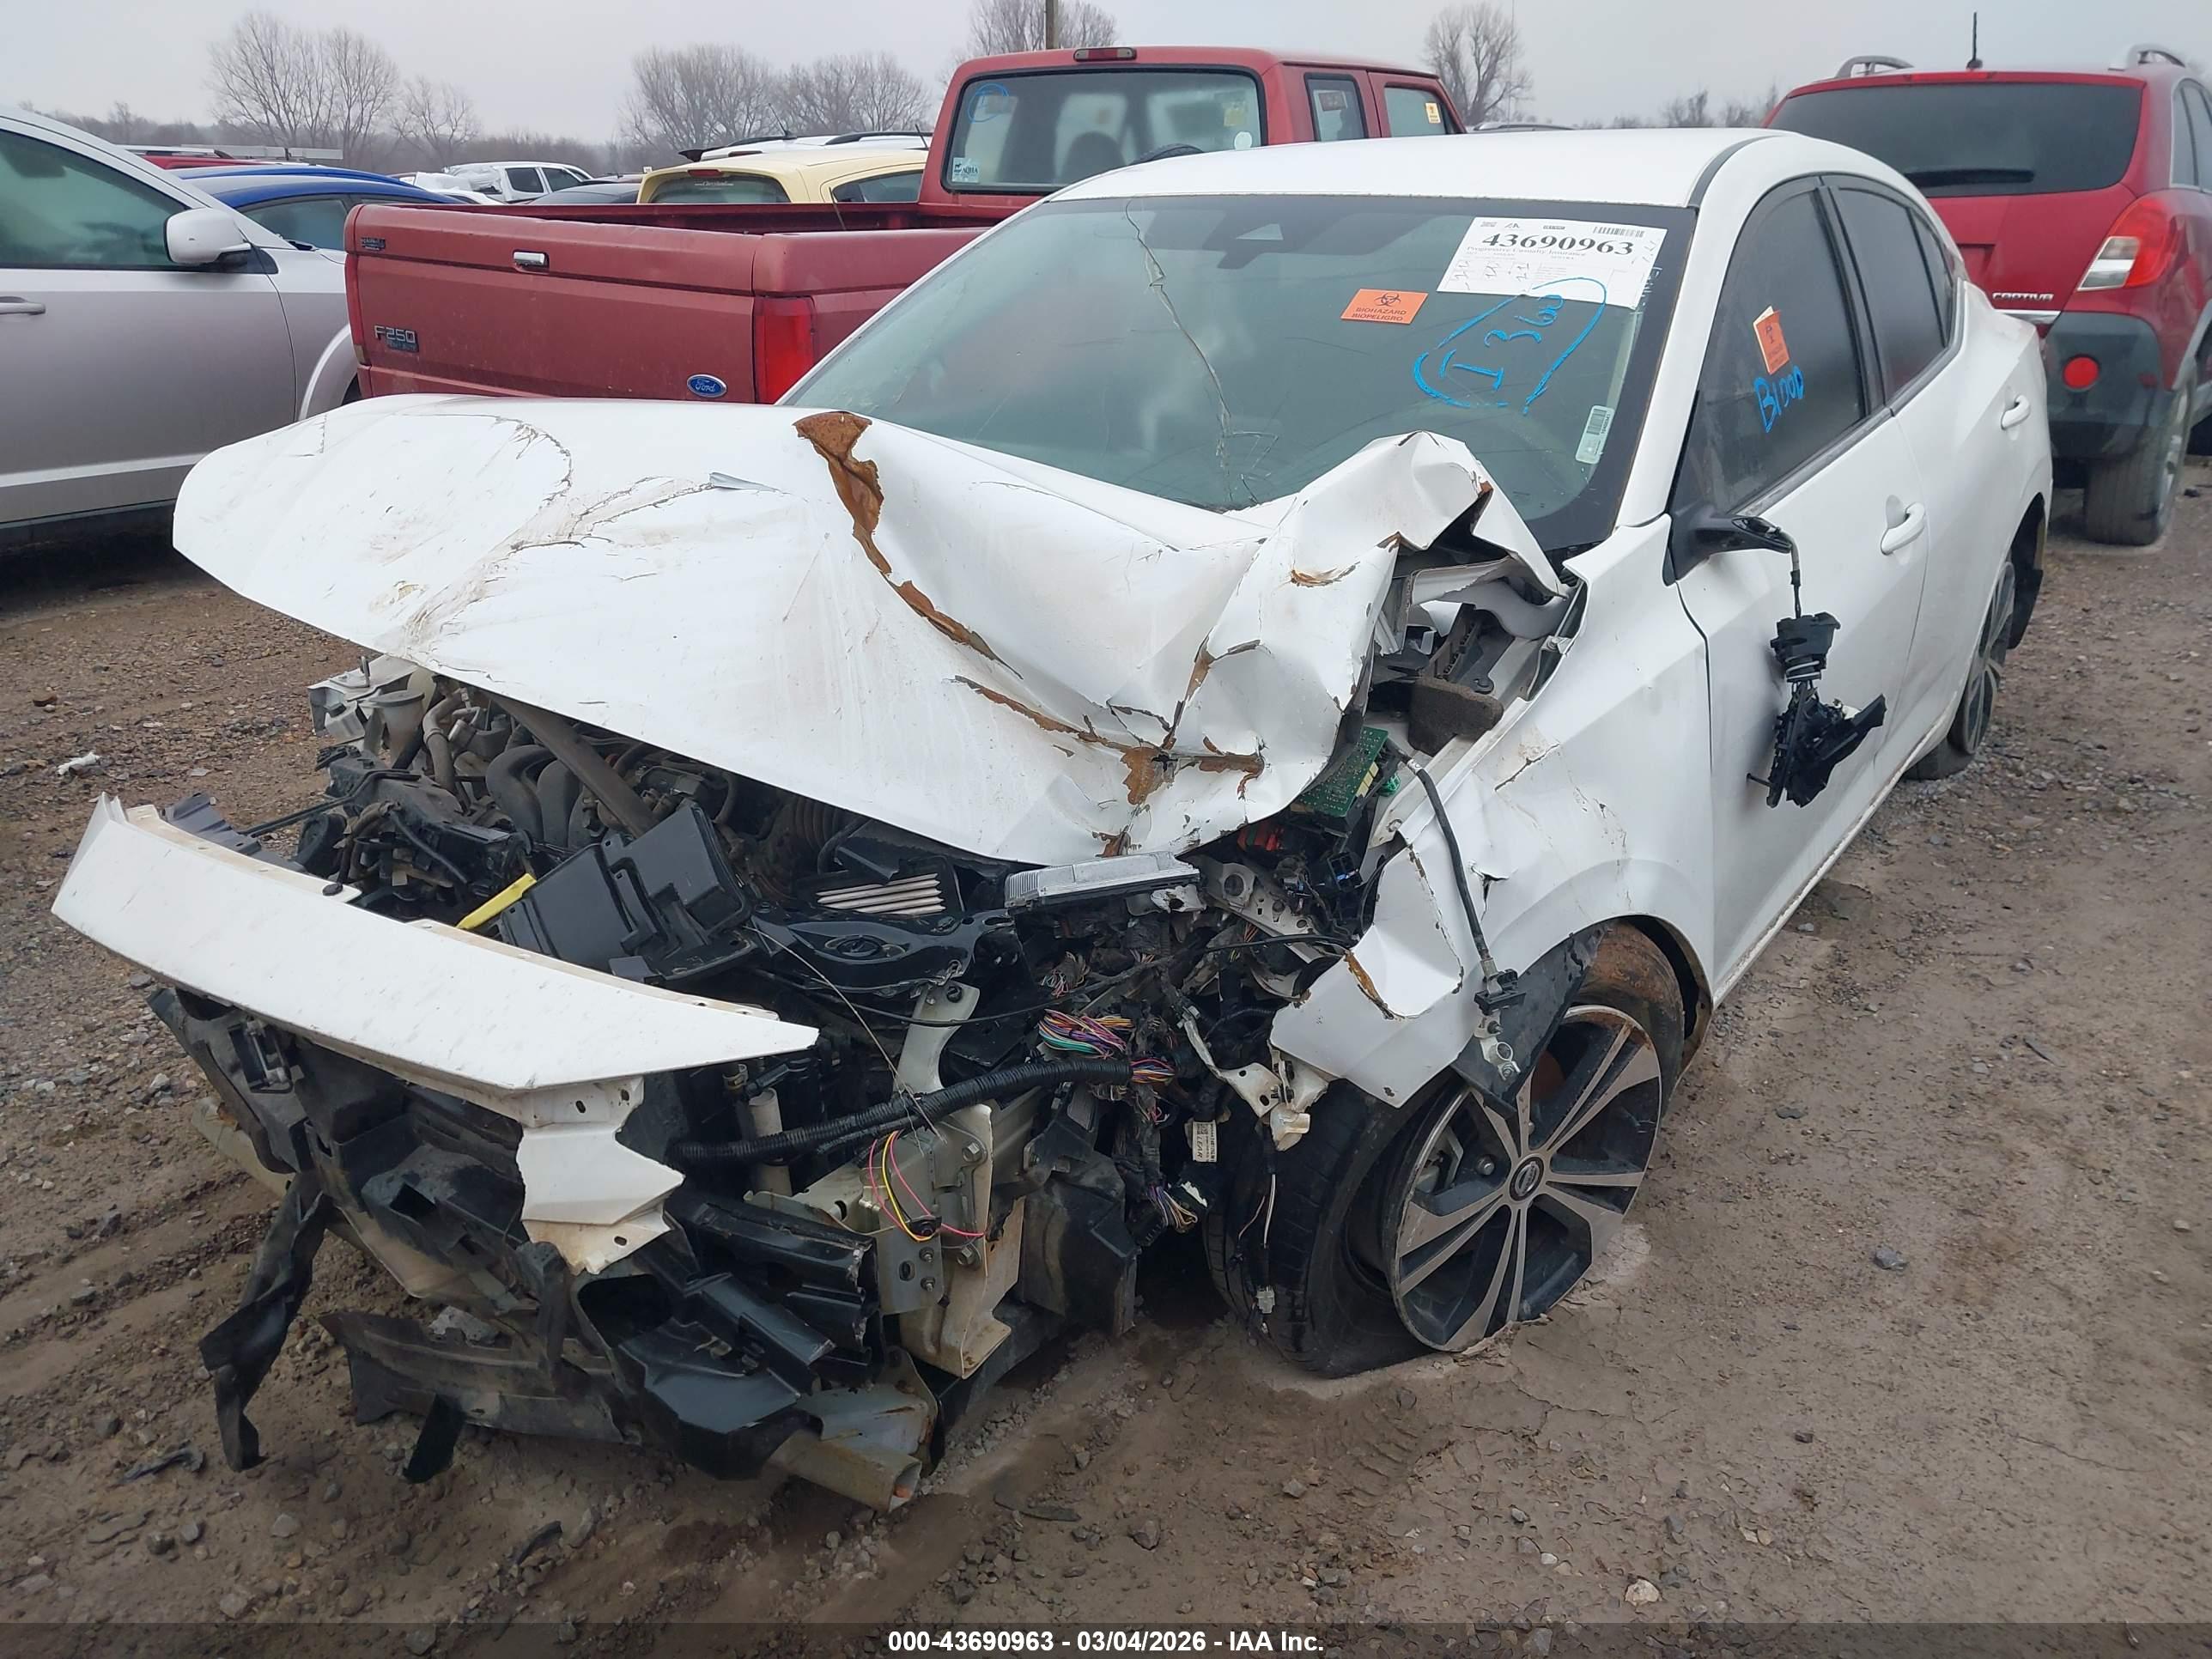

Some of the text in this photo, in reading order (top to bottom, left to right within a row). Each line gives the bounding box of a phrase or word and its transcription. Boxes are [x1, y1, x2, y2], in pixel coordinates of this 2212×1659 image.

[1482, 233, 1633, 255] 43690963
[1352, 313, 1403, 321] BIOPELIGRO
[1356, 307, 1407, 315] BIOHAZARD
[374, 325, 416, 343] F250
[695, 378, 717, 392] Ford
